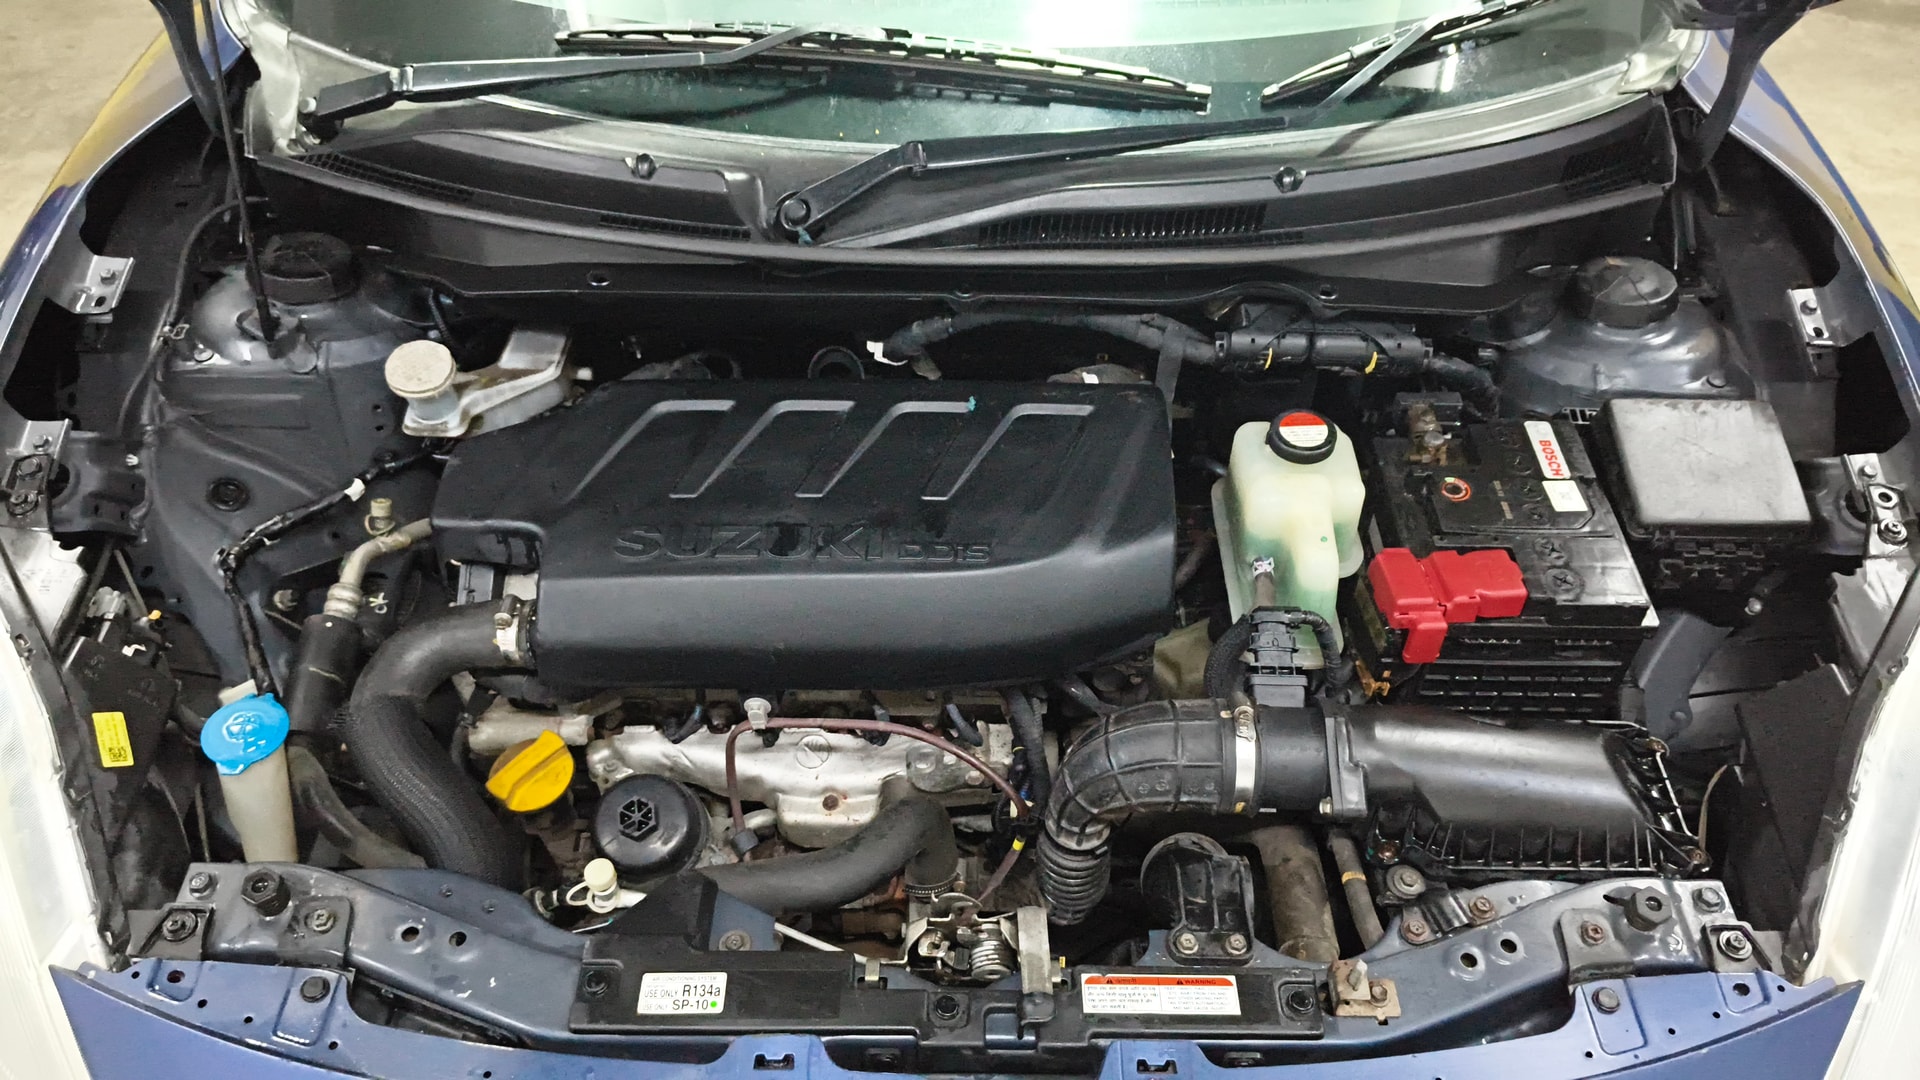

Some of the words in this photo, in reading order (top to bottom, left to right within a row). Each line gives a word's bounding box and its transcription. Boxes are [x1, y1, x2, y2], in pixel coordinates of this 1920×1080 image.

[1539, 439, 1564, 477] BOSCH
[613, 524, 884, 561] SUZUKI
[644, 988, 657, 998] USE
[660, 989, 678, 998] ONLY
[682, 984, 721, 997] R134a
[672, 999, 709, 1010] SP-10
